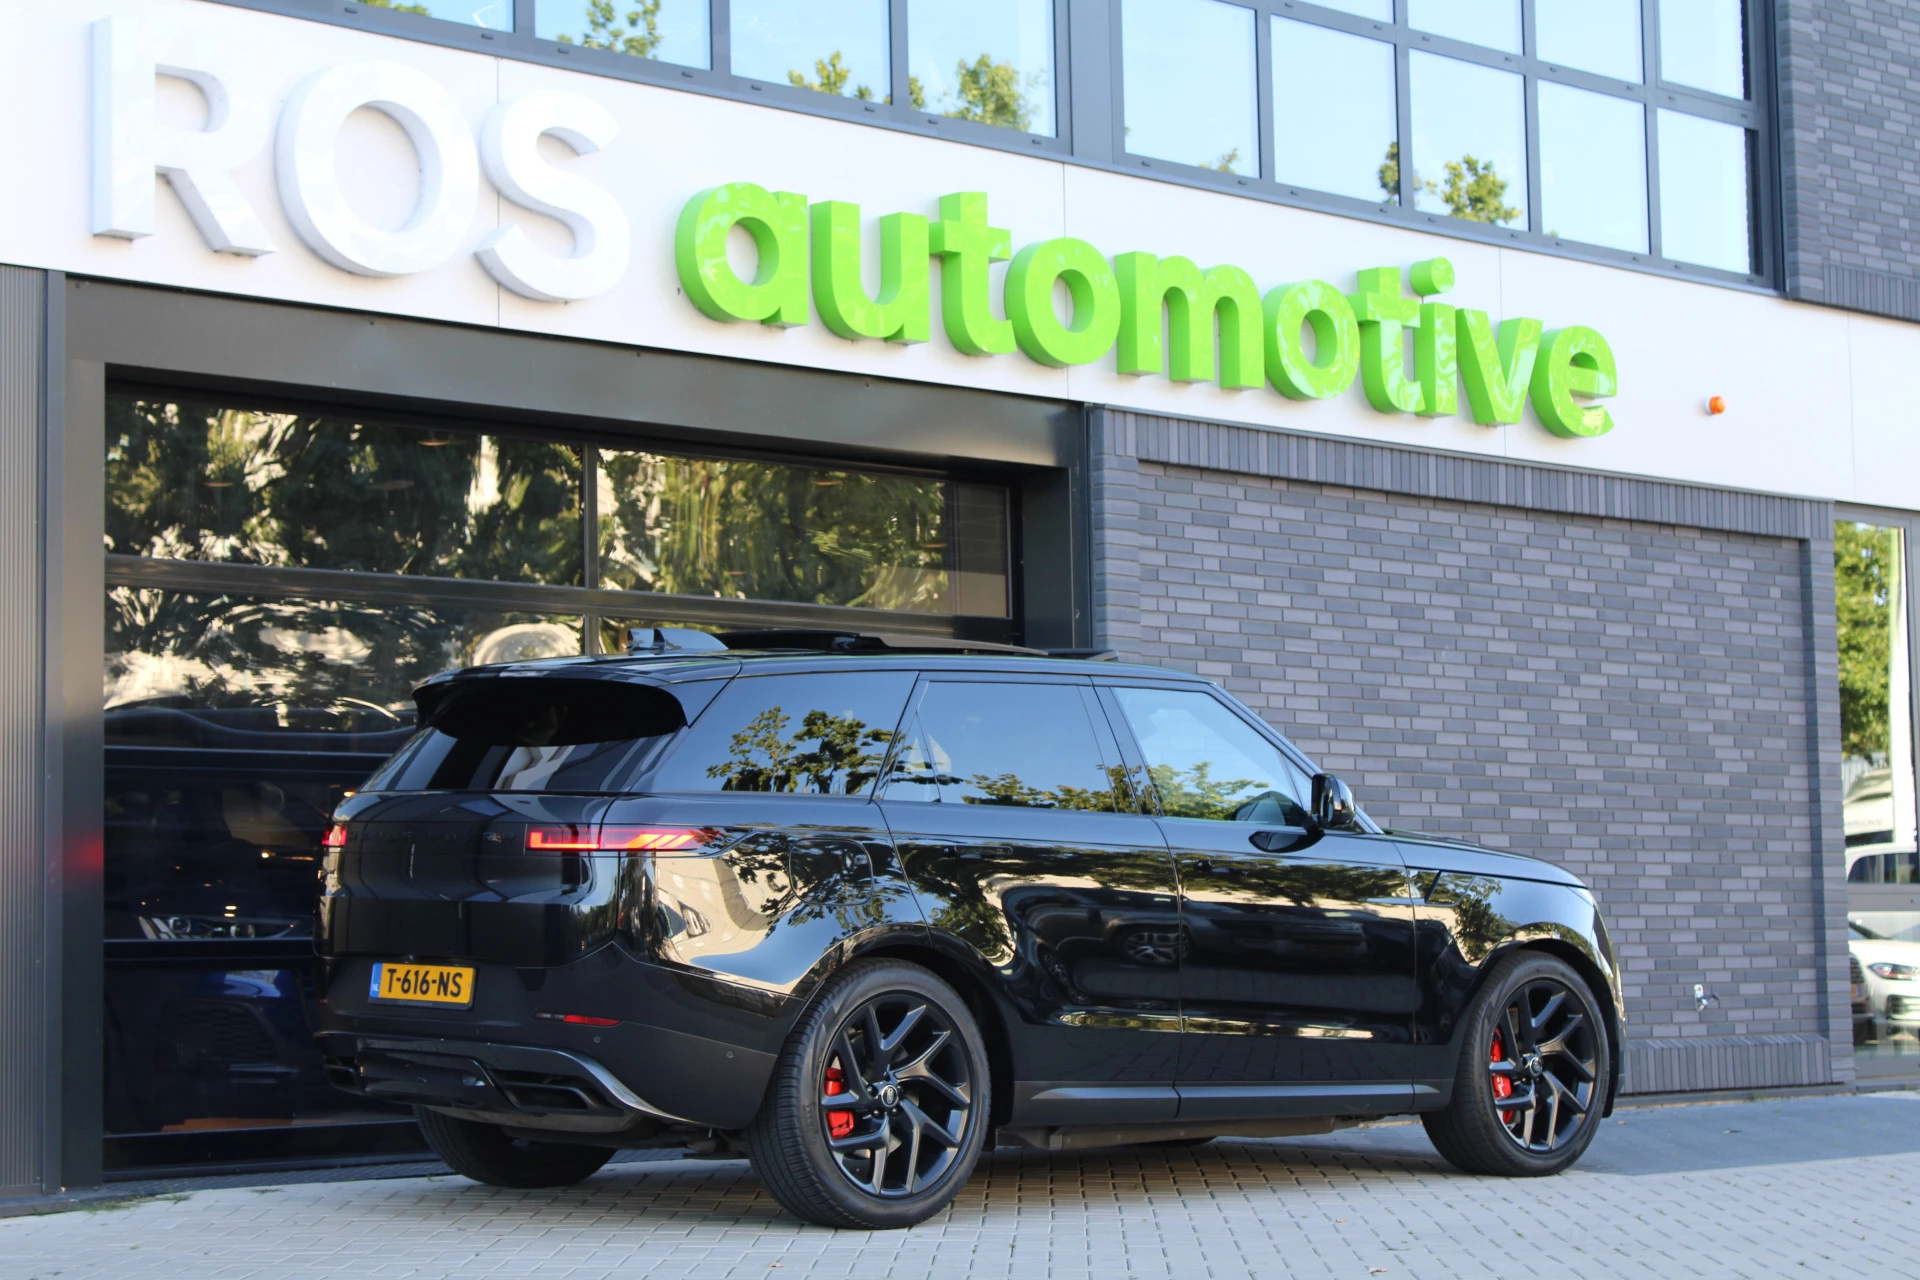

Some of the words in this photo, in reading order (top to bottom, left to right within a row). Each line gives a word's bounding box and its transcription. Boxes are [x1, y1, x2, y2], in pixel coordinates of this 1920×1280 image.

[91, 15, 631, 302] ROS
[675, 182, 1617, 438] automotive
[387, 968, 463, 998] T-616-NS
